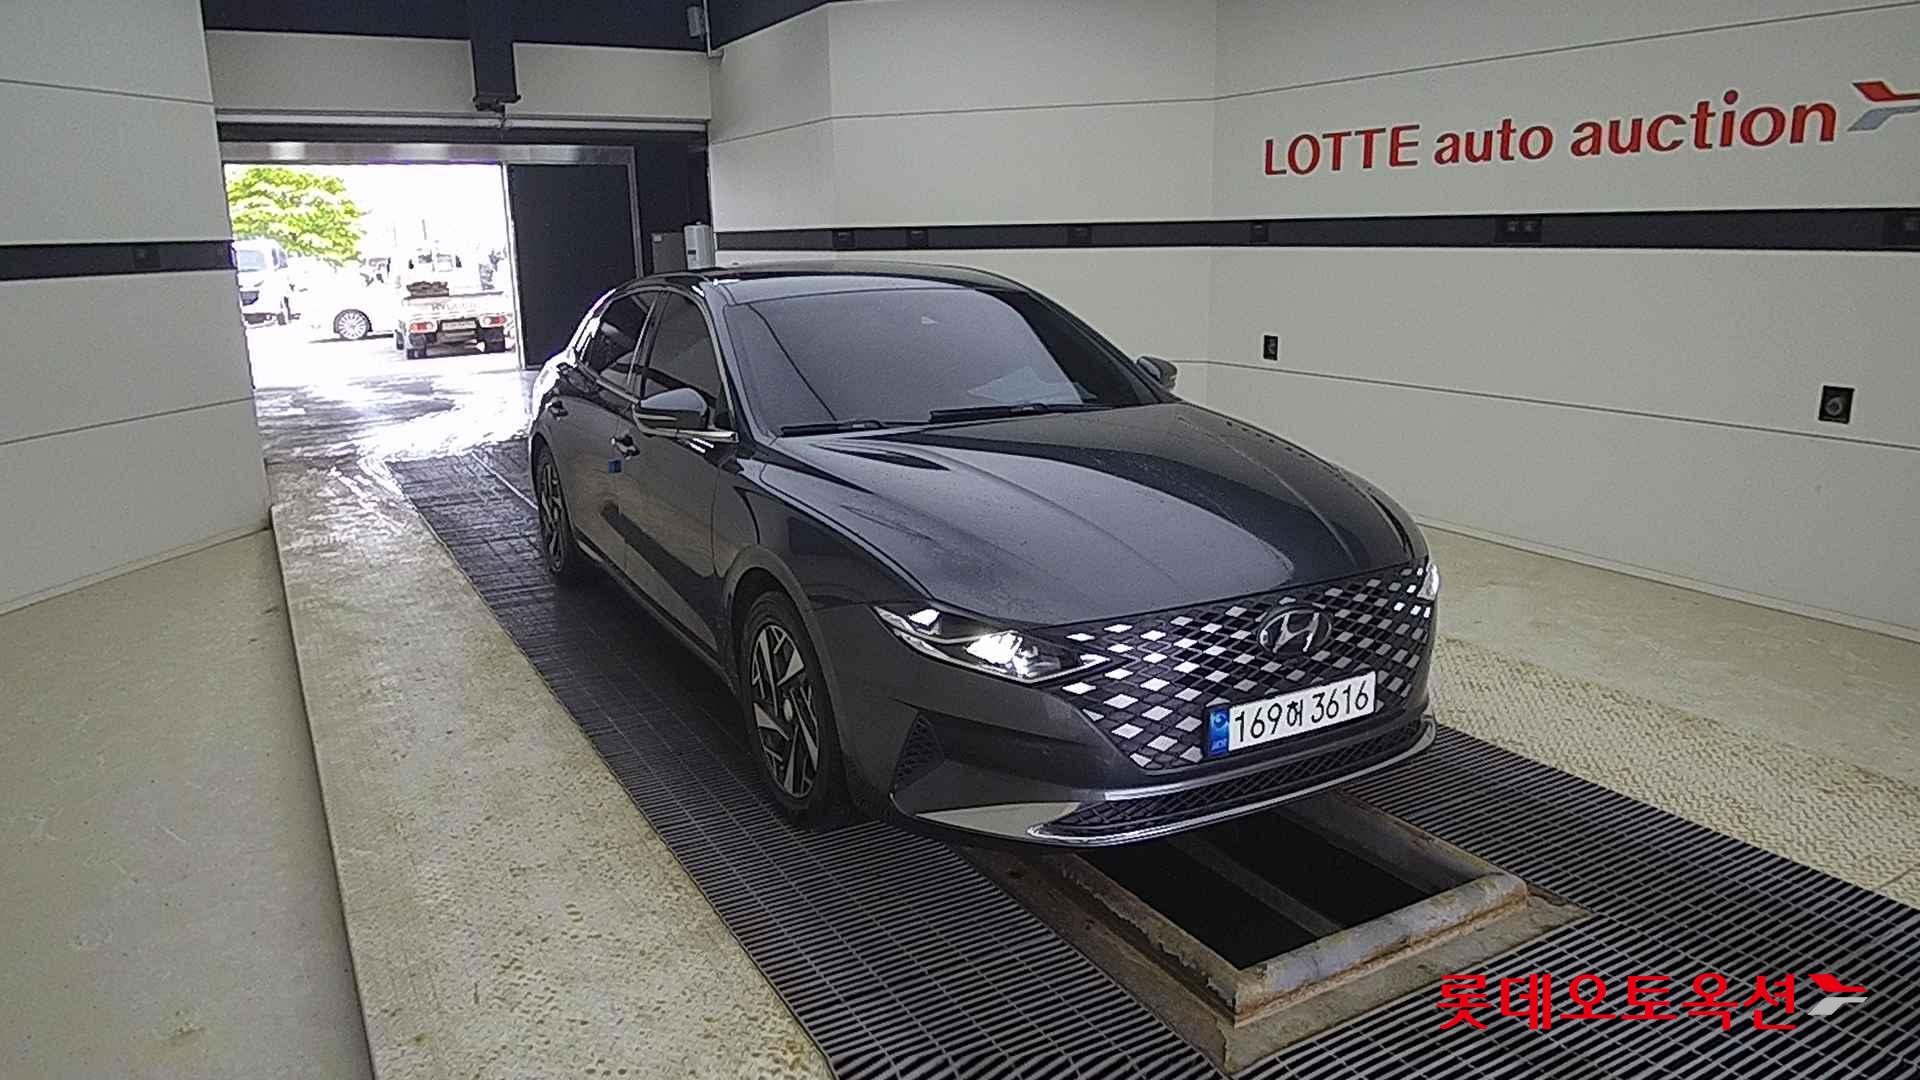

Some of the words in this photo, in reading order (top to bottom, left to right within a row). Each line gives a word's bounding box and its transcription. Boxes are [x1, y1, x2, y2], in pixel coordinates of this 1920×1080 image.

[1264, 125, 1421, 176] LOTTE
[1434, 118, 1554, 164] auto
[1570, 90, 1837, 158] auction
[1311, 680, 1369, 724] 3616
